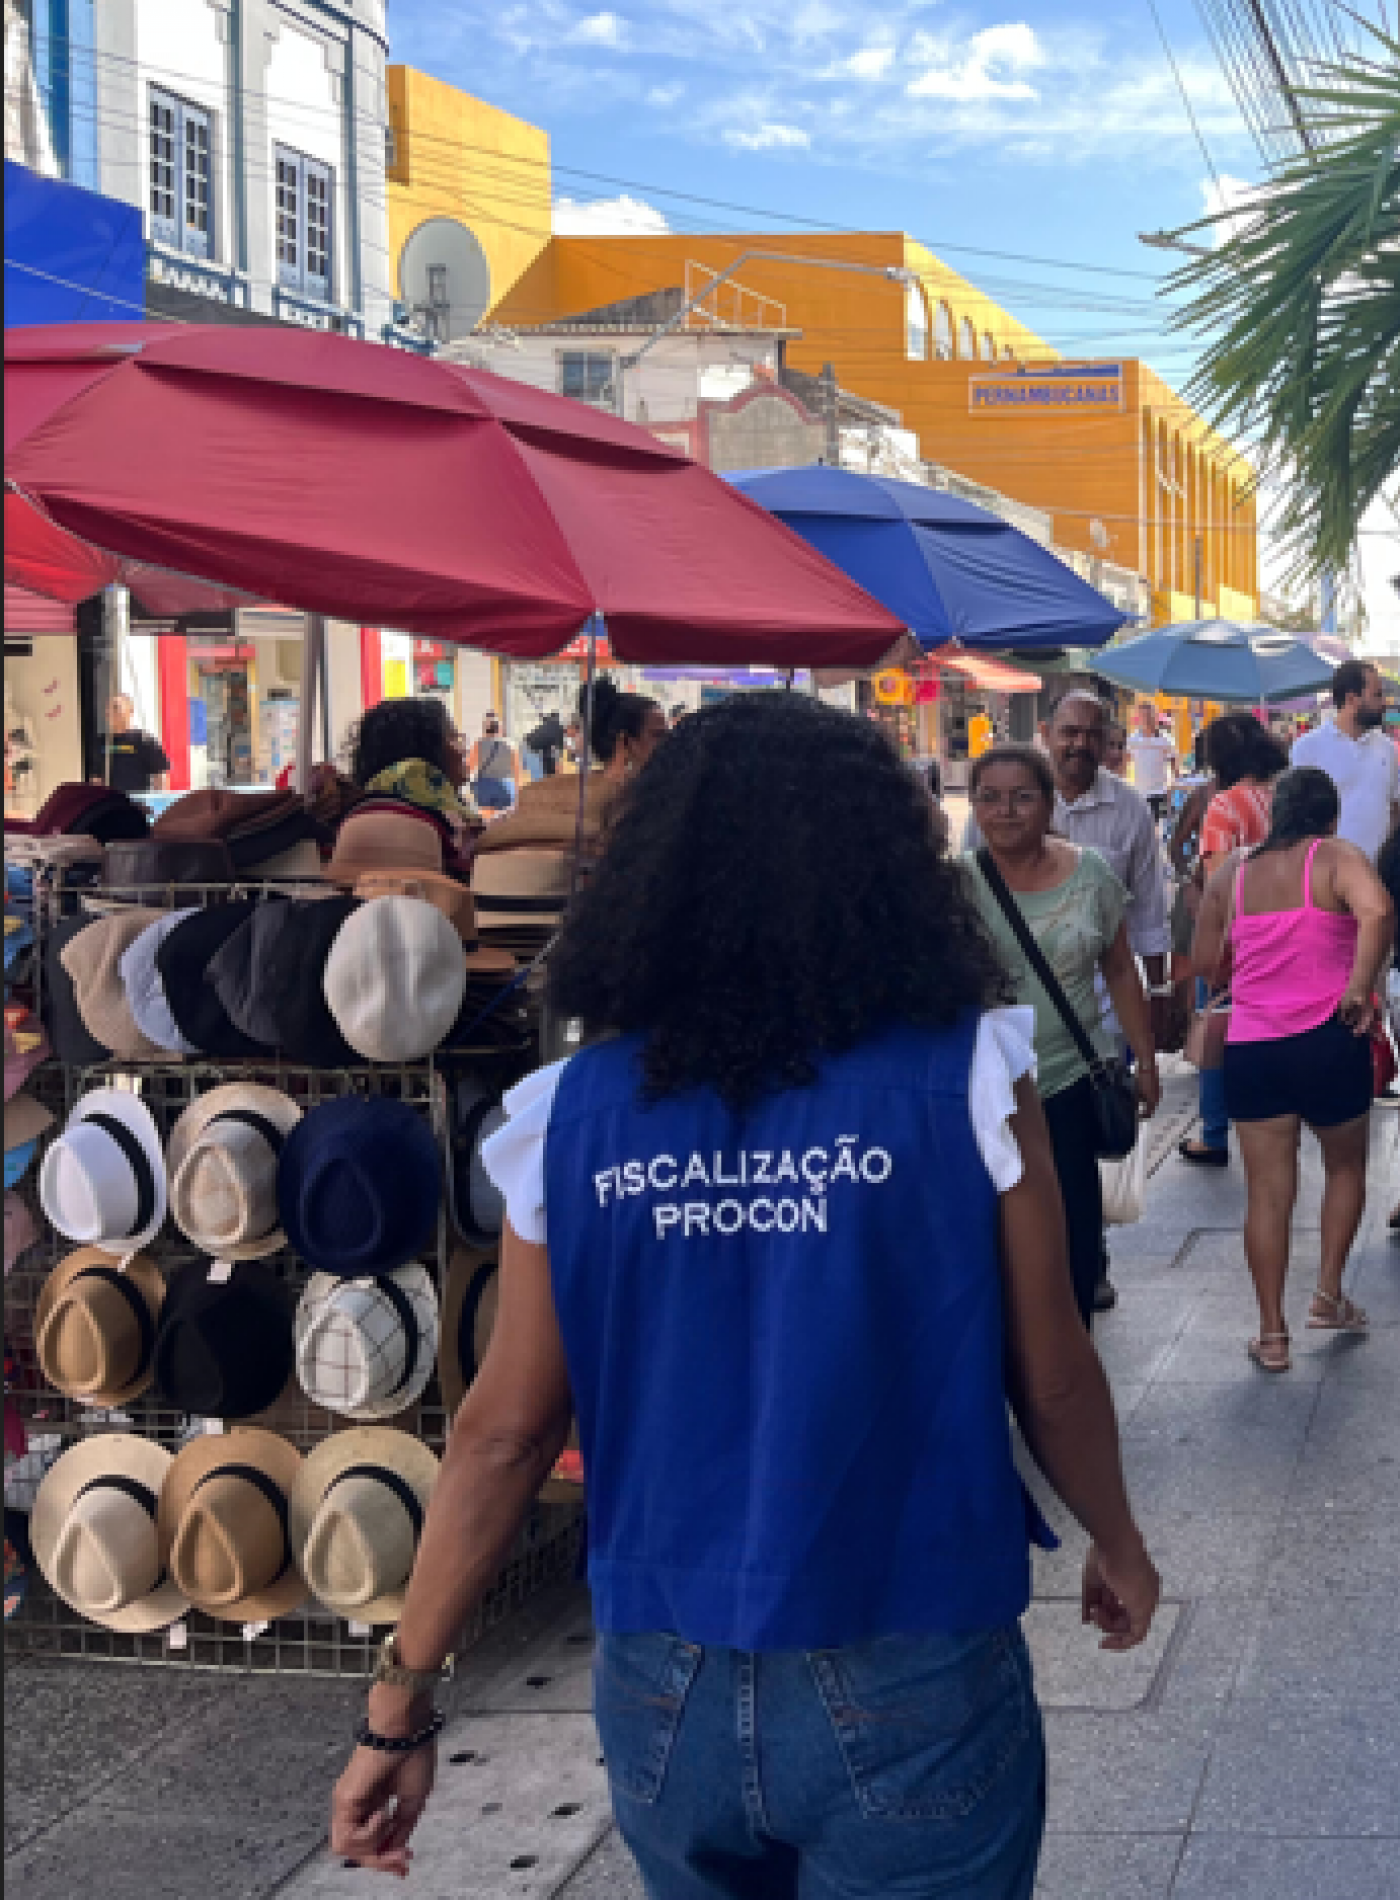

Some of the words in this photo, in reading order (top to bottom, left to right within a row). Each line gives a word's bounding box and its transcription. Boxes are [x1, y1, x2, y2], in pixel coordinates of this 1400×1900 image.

[974, 384, 1120, 405] PERNAMBUCANAS
[593, 1134, 892, 1207] FISCALIZAÇÃO
[653, 1197, 828, 1239] PROCON
